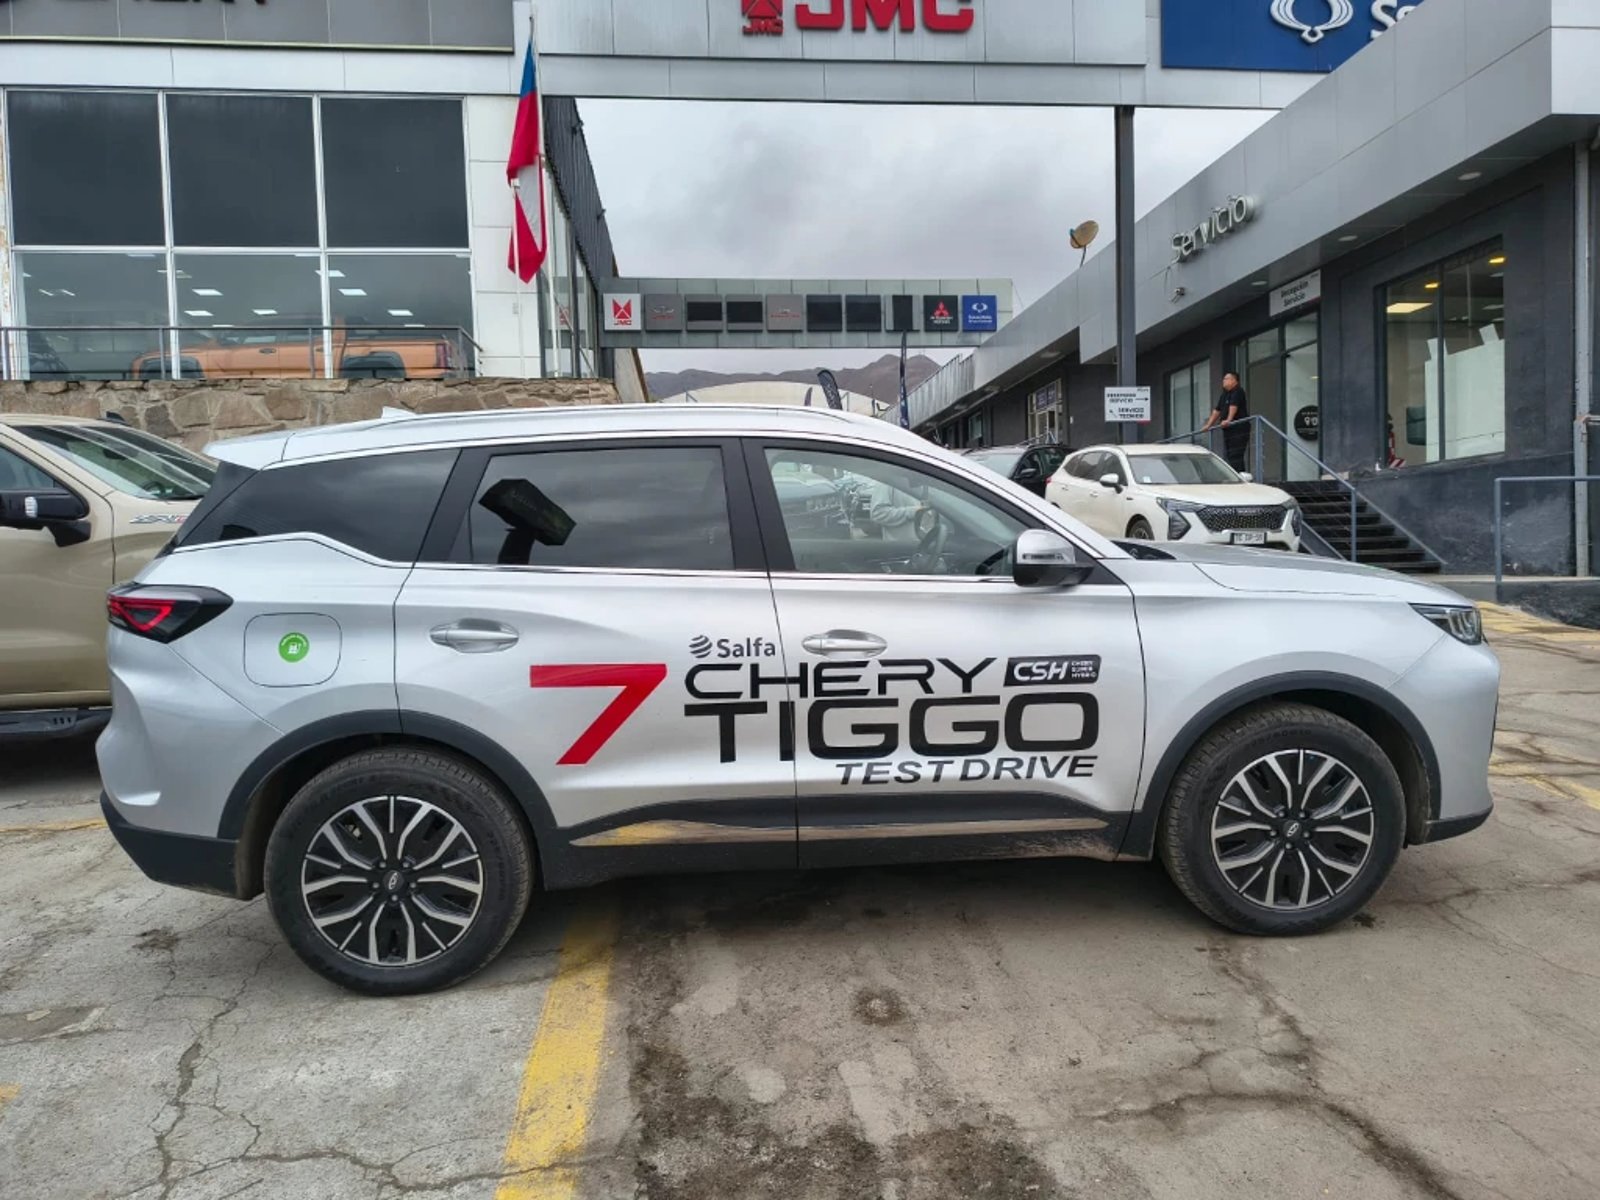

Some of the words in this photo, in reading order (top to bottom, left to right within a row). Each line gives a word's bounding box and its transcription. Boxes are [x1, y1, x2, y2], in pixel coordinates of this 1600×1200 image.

[796, 0, 974, 31] JMC
[1171, 193, 1252, 264] Servicio
[717, 637, 776, 658] Salfa
[684, 657, 997, 699] CHERY
[1013, 661, 1069, 681] CSH
[530, 663, 667, 765] 7
[684, 692, 1099, 762] TIGGO
[836, 760, 954, 785] TEST
[959, 755, 1098, 782] DRIVE
